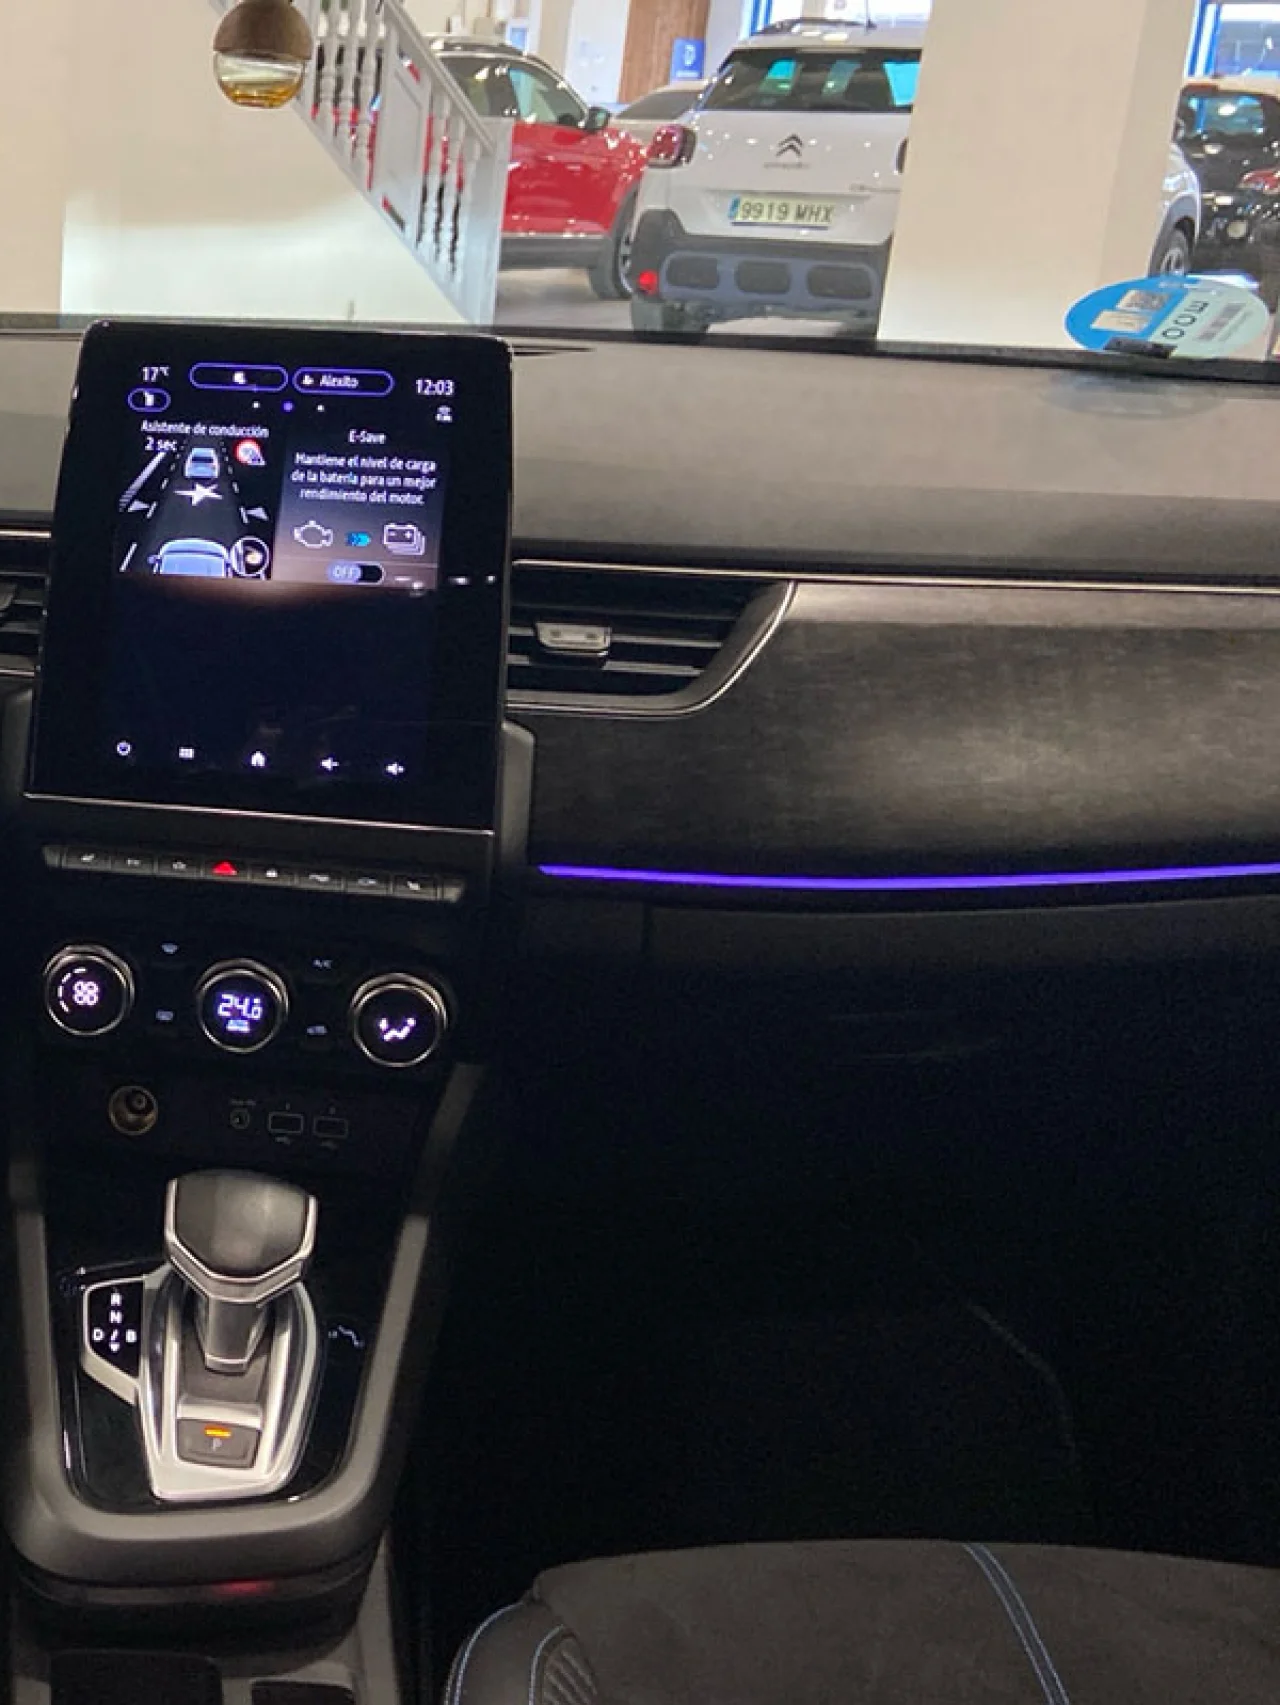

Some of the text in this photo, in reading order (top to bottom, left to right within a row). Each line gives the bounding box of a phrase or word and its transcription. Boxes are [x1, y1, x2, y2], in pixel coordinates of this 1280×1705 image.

[741, 202, 835, 223] 9919 MHX
[415, 379, 455, 397] 12:03
[141, 420, 270, 438] Asistente de conducción
[348, 429, 386, 444] E-Save
[144, 436, 178, 452] 2 sec
[294, 452, 437, 474] Mantiene el nivel de carga
[291, 469, 437, 491] de la batería para un mejor
[300, 488, 368, 502] rendimiento
[368, 489, 387, 503] del
